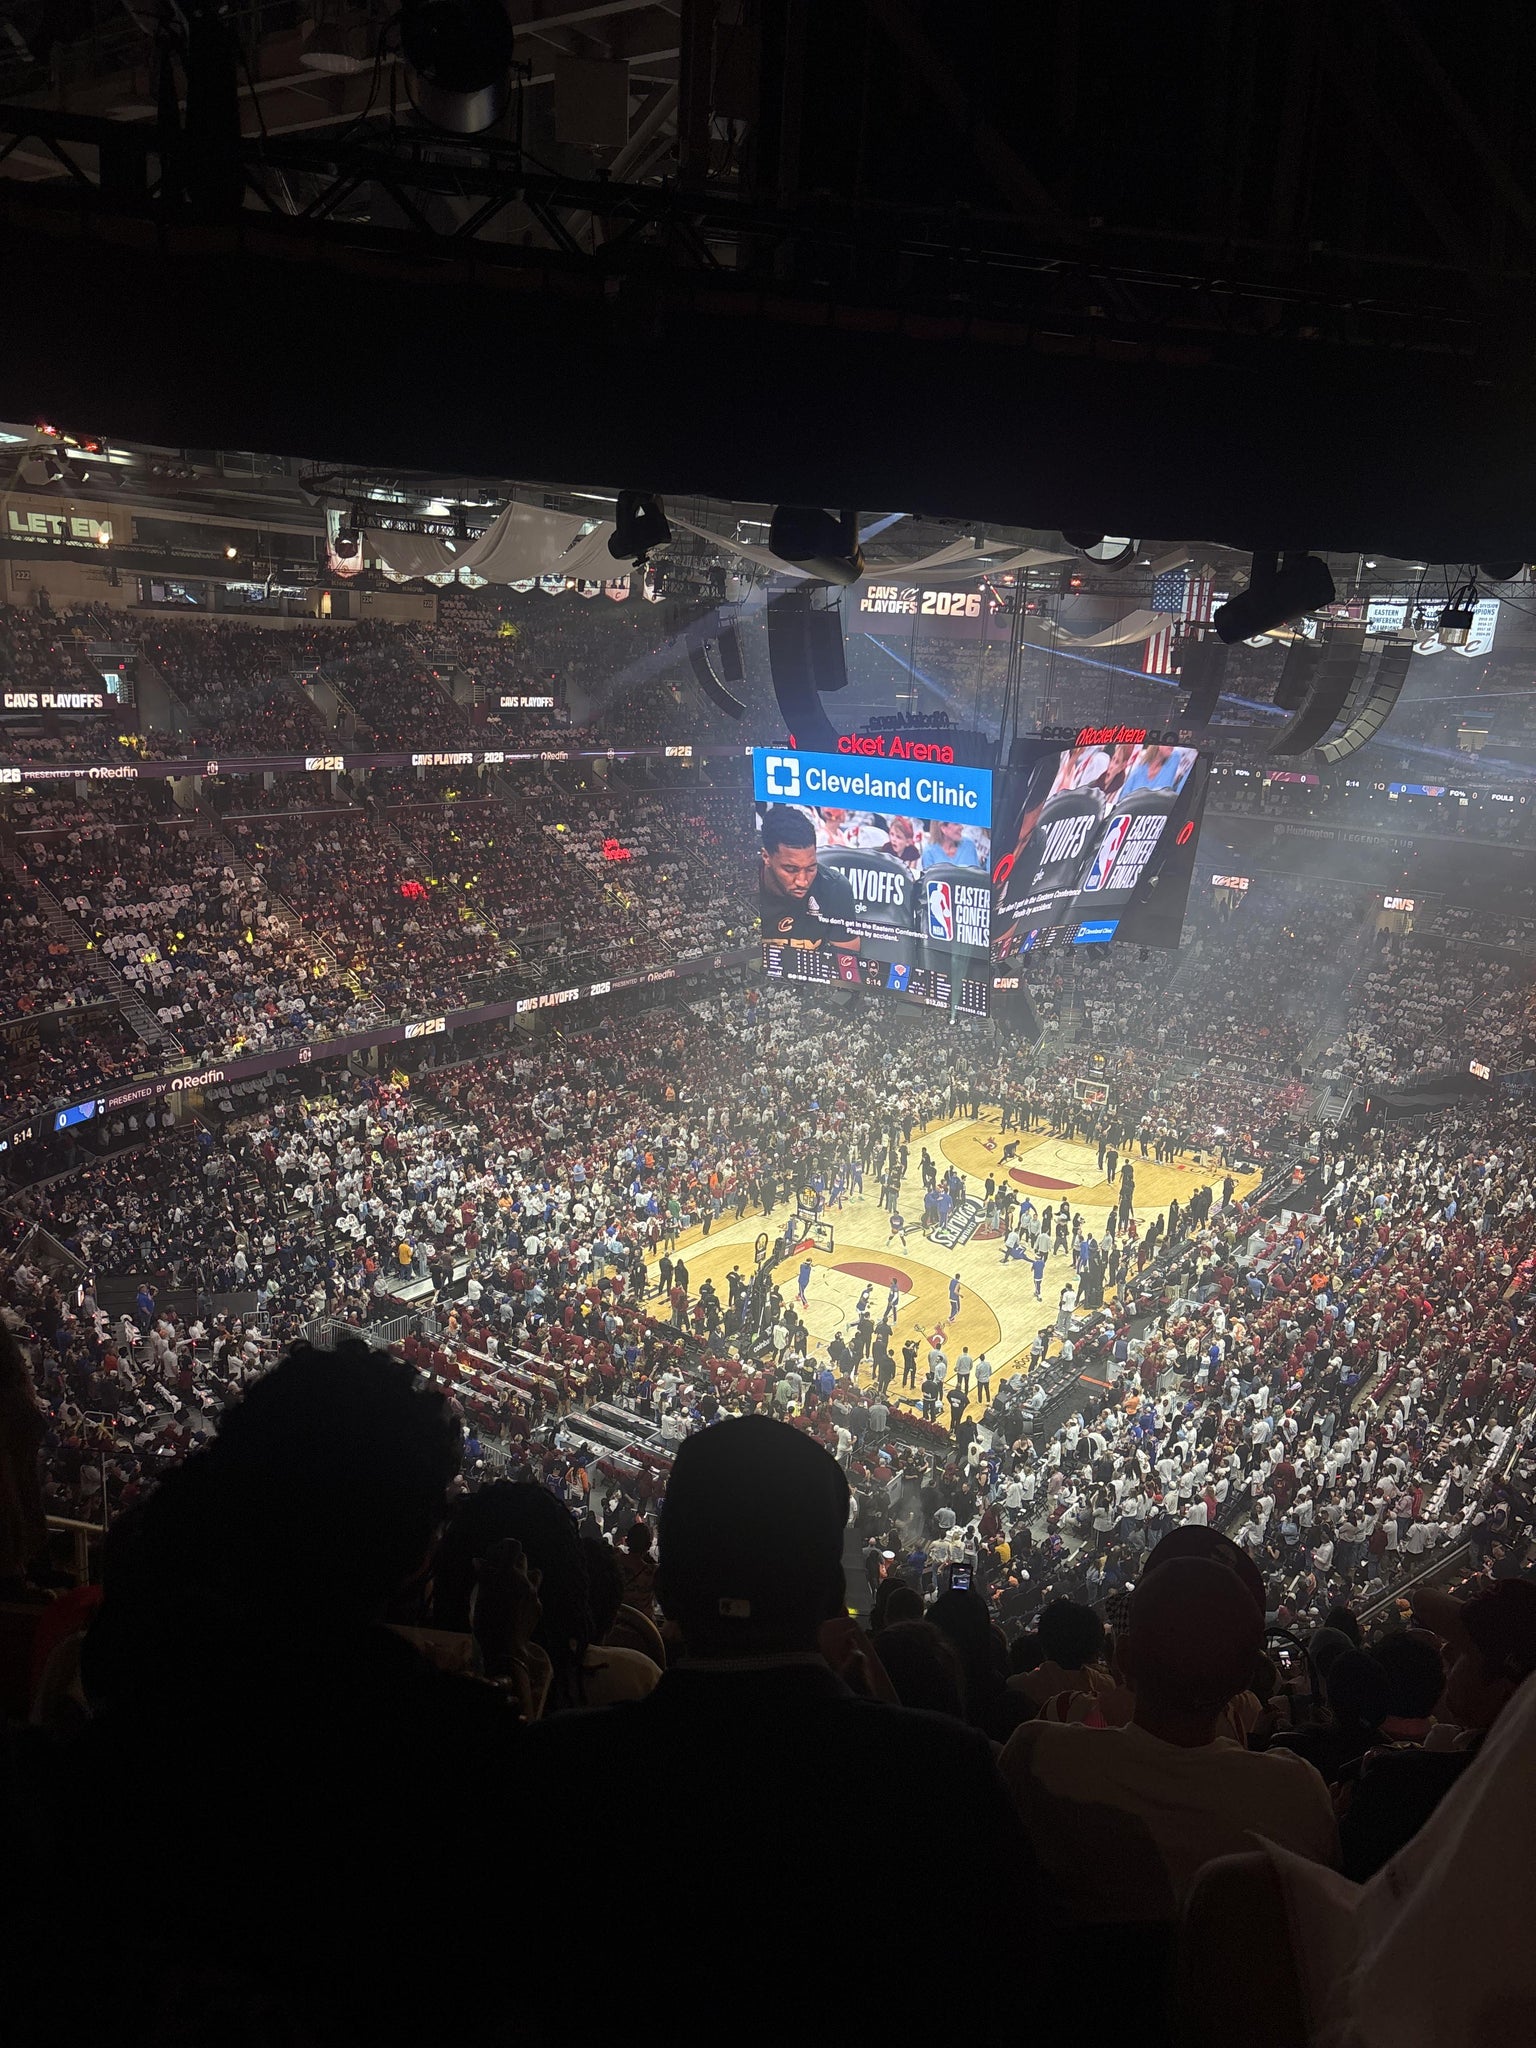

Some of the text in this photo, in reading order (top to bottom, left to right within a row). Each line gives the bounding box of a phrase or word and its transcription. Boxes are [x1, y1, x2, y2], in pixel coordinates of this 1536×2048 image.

[8, 511, 113, 540] LET EM
[867, 586, 898, 600] CAVS
[860, 599, 917, 614] PLAYOFFS
[921, 591, 981, 617] 2026
[1374, 608, 1399, 616] EASTERN
[4, 694, 103, 708] CAVS PLAYOFFS
[500, 697, 554, 708] CAVS PLAYOFFS
[1084, 725, 1117, 744] Rocket
[1115, 724, 1146, 743] Arena
[838, 732, 954, 764] cket Arena
[412, 754, 432, 766] CAVS
[434, 753, 473, 766] PLAYOFFS
[484, 752, 504, 763] 2026
[547, 751, 568, 760] Redfin
[24, 770, 70, 779] PRESENTED
[100, 766, 138, 778] Redfin
[806, 767, 978, 809] Cleveland Clinic
[1492, 794, 1514, 802] FOULS
[1286, 824, 1335, 840] Huntington
[1105, 865, 1143, 890] FINALS
[830, 866, 905, 906] AYOFFS
[1037, 892, 1054, 902] Eastern
[1054, 888, 1082, 898] Conference
[855, 902, 867, 914] gle
[1383, 896, 1415, 912] CAVS
[1012, 910, 1026, 919] Finals
[830, 918, 845, 926] don't
[872, 924, 894, 933] Eastern
[895, 928, 928, 939] Conference
[846, 928, 864, 936] Finals
[873, 932, 899, 942] accident.
[932, 925, 944, 937] NBA
[956, 924, 990, 948] FINALS
[846, 970, 852, 980] 0
[866, 978, 882, 986] 5:14
[894, 980, 900, 988] 0
[994, 978, 1019, 988] CAVS
[516, 997, 538, 1013] CAVS
[539, 988, 579, 1009] PLAYOFFS
[590, 981, 611, 997] 2026
[612, 978, 638, 988] PRESENTED
[653, 968, 676, 982] Redfin
[1469, 1060, 1491, 1080] CAVS
[109, 1070, 224, 1107] PRESENTED BY Redfin
[98, 1106, 104, 1114] 0
[60, 1114, 66, 1126] 0
[13, 1127, 33, 1145] 5:14
